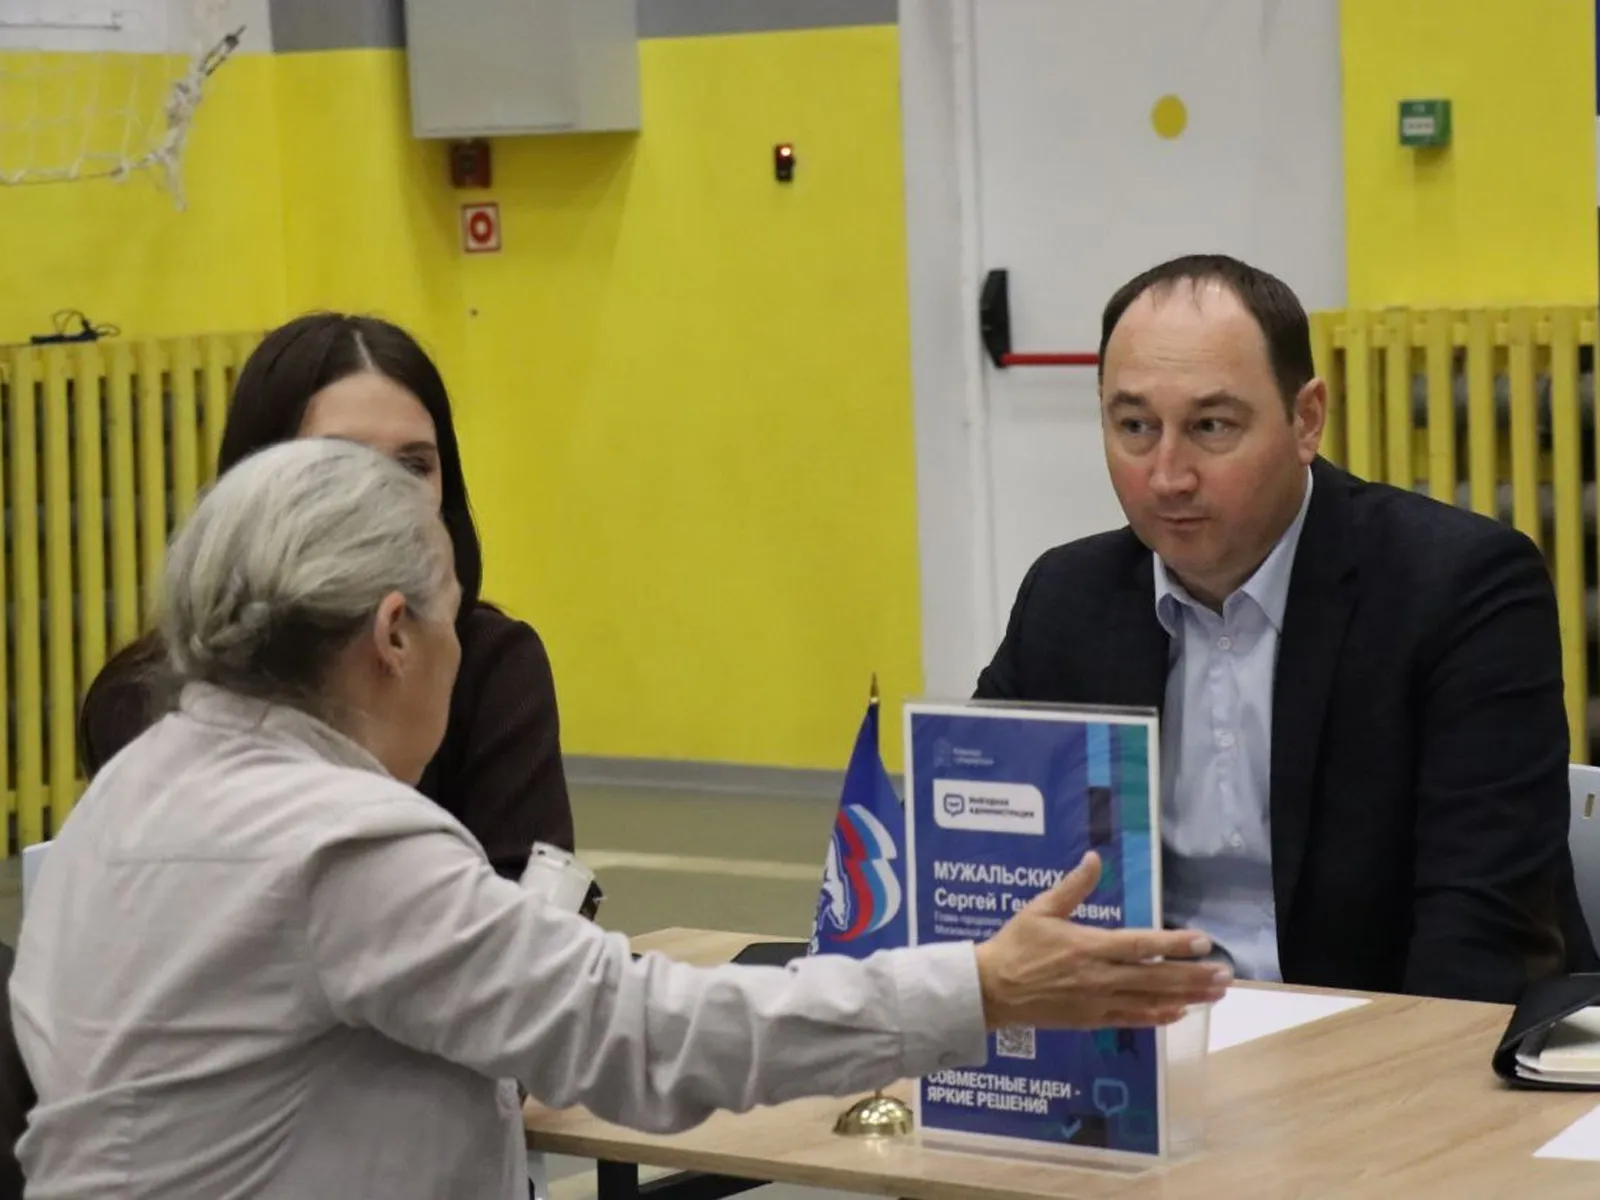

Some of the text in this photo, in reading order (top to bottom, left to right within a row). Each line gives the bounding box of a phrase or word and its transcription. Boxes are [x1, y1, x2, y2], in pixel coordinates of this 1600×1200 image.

[934, 860, 1064, 888] МУЖАЛЬСКИХ
[934, 886, 997, 912] Сергей
[927, 1069, 1027, 1094] СОВМЕСТНЫЕ
[1030, 1078, 1072, 1099] ИДЕИ
[927, 1085, 1049, 1115] ЯРКИЕ РЕШЕНИЯ
